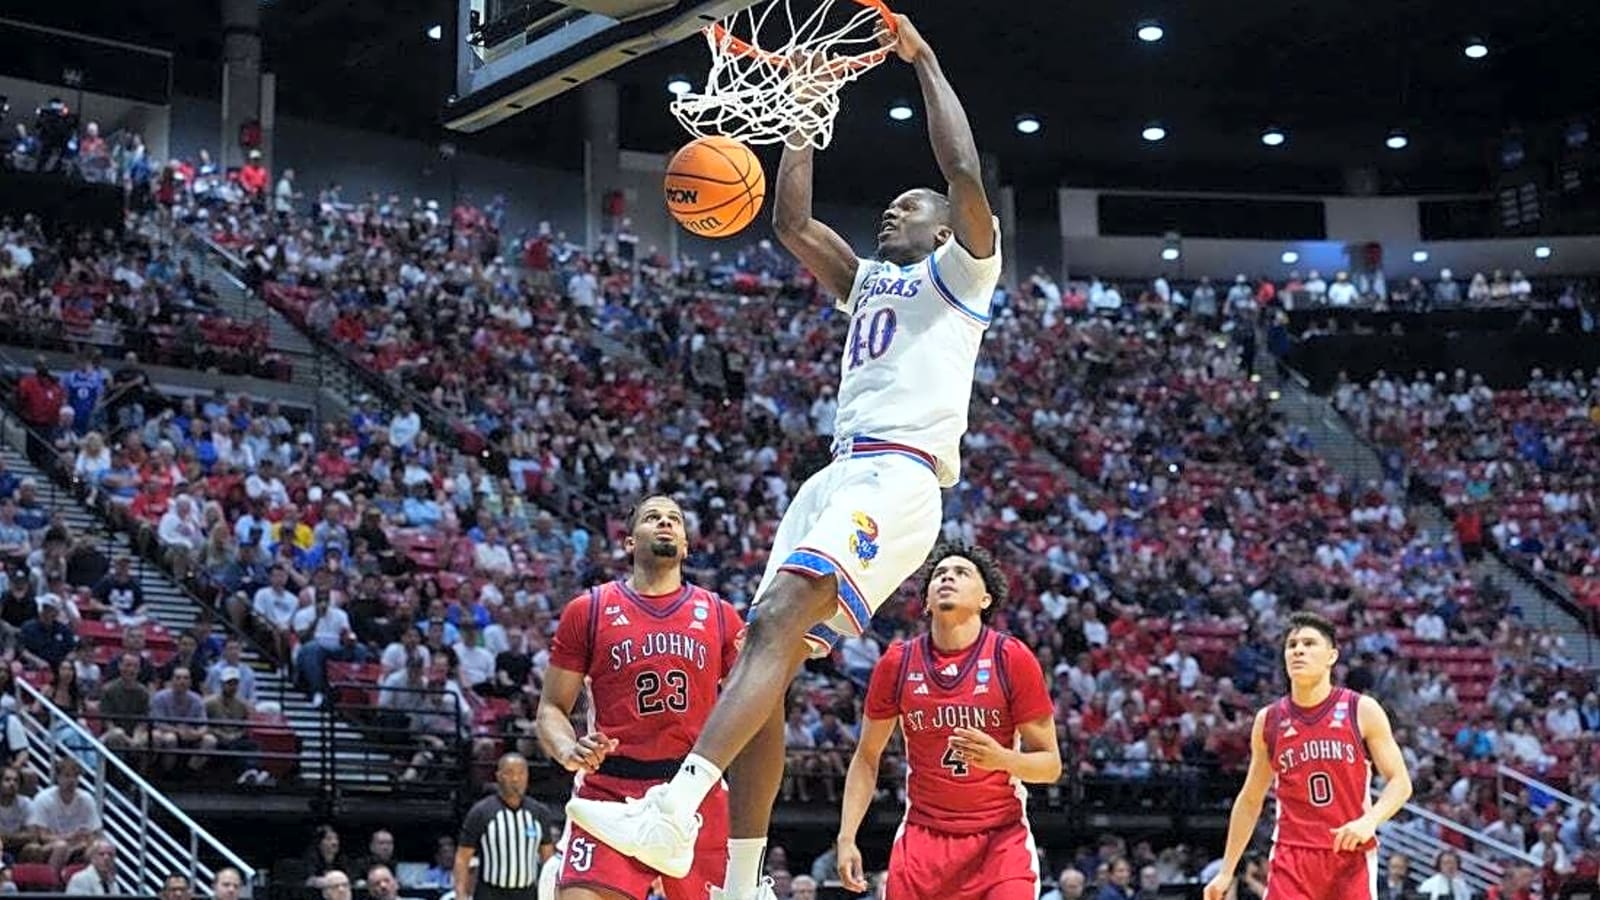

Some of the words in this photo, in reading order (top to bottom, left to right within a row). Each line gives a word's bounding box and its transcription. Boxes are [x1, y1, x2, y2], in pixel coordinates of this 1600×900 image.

[849, 307, 897, 370] 40
[611, 639, 637, 671] ST.
[642, 631, 706, 670] JOHN'S
[635, 669, 689, 716] 23
[907, 710, 928, 731] ST.
[932, 705, 1001, 728] JOHN'S
[941, 738, 968, 777] 4
[1278, 748, 1298, 773] ST.
[1300, 739, 1355, 764] JOHN'S
[1308, 770, 1334, 807] 0
